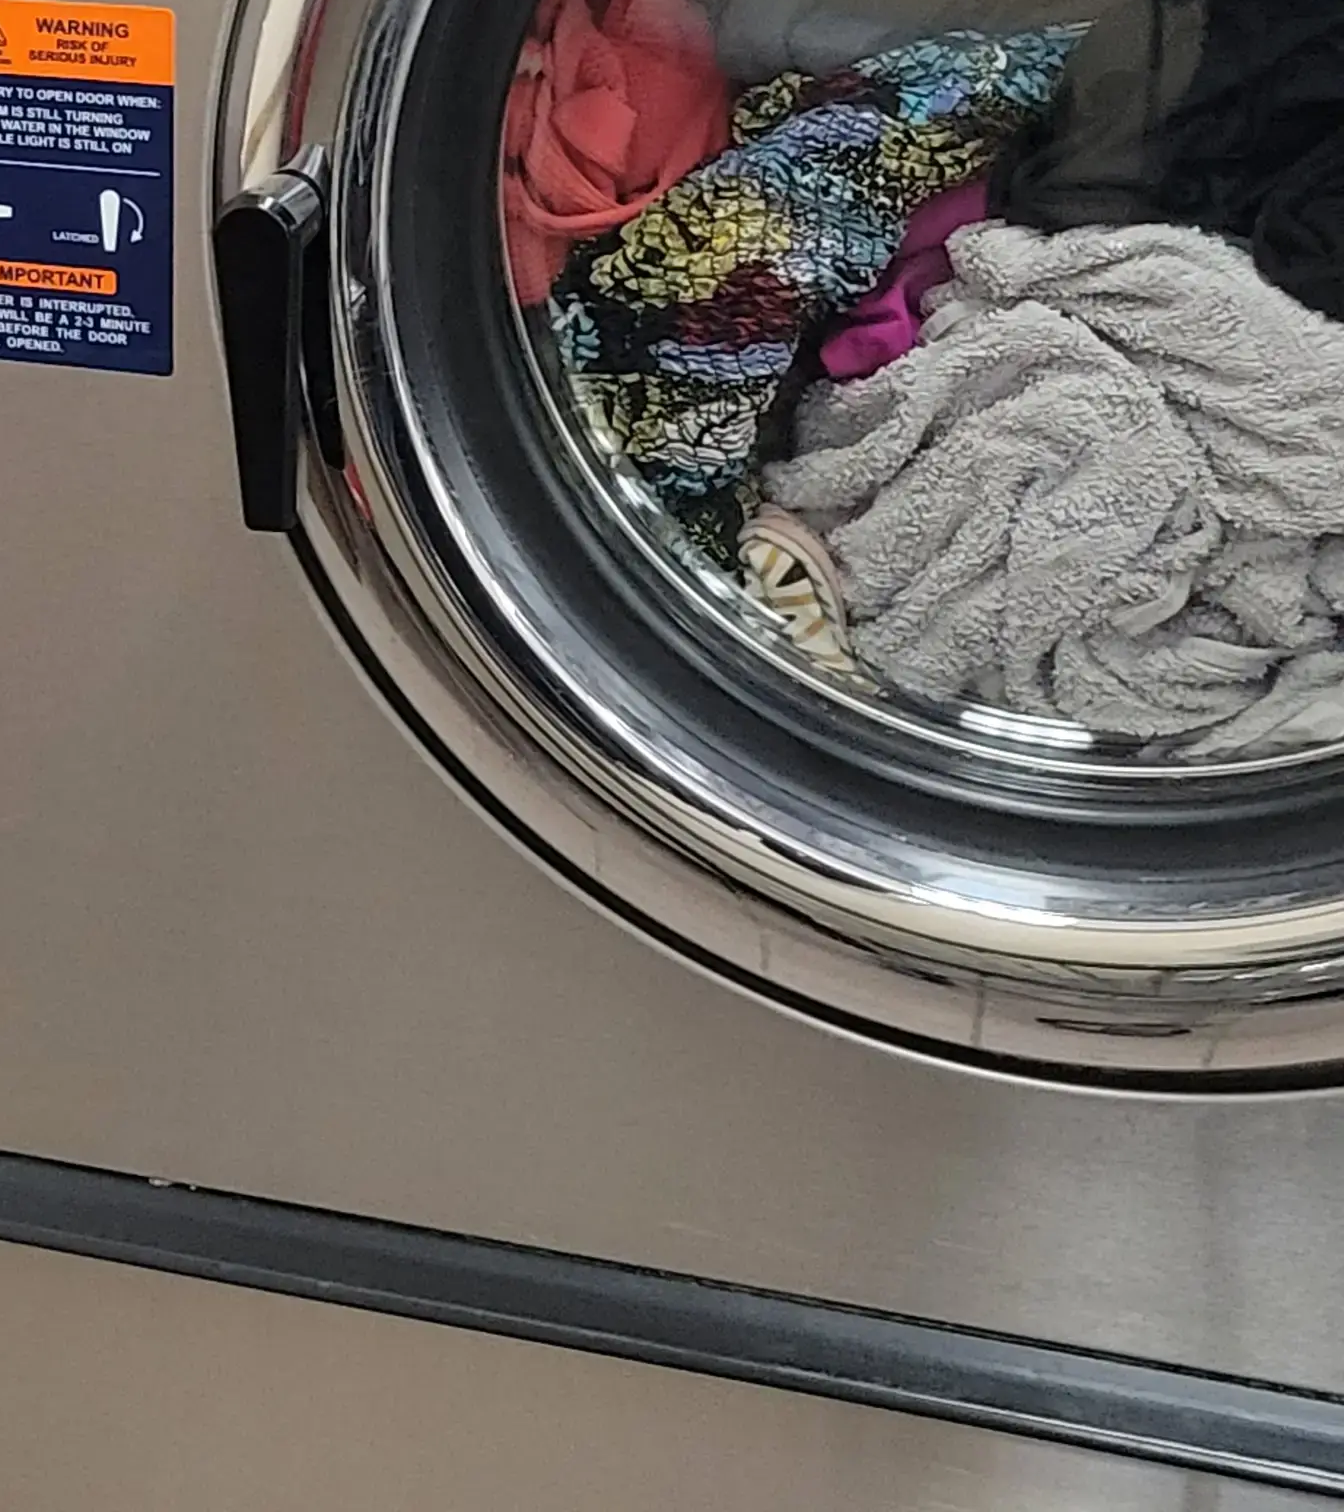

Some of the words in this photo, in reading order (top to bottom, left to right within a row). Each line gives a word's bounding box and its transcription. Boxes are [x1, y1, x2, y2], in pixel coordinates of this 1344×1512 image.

[35, 17, 130, 39] WARNING
[56, 38, 88, 52] RISK
[90, 39, 109, 53] OF
[28, 49, 86, 65] SERIOUS
[89, 52, 137, 68] INJURY
[15, 86, 34, 100] TO
[36, 88, 74, 104] OPEN
[75, 90, 115, 106] DOOR
[116, 93, 162, 110] WHEN:
[11, 104, 24, 118] IS
[26, 106, 62, 121] STILL
[64, 108, 124, 126] TURNING
[0, 118, 47, 134] WATER
[48, 121, 63, 136] IN
[64, 122, 91, 138] THE
[93, 124, 151, 142] WINDOW
[17, 133, 57, 149] LIGHT
[58, 135, 71, 150] IS
[73, 137, 110, 153] STILL
[111, 140, 133, 155] ON
[52, 230, 100, 245] LATCHED
[20, 295, 34, 309] IS
[34, 310, 53, 325] BE
[58, 313, 70, 326] A
[99, 317, 152, 335] MINUTE
[6, 335, 65, 353] OPENED.
[55, 325, 82, 341] THE
[87, 329, 128, 346] DOOR
